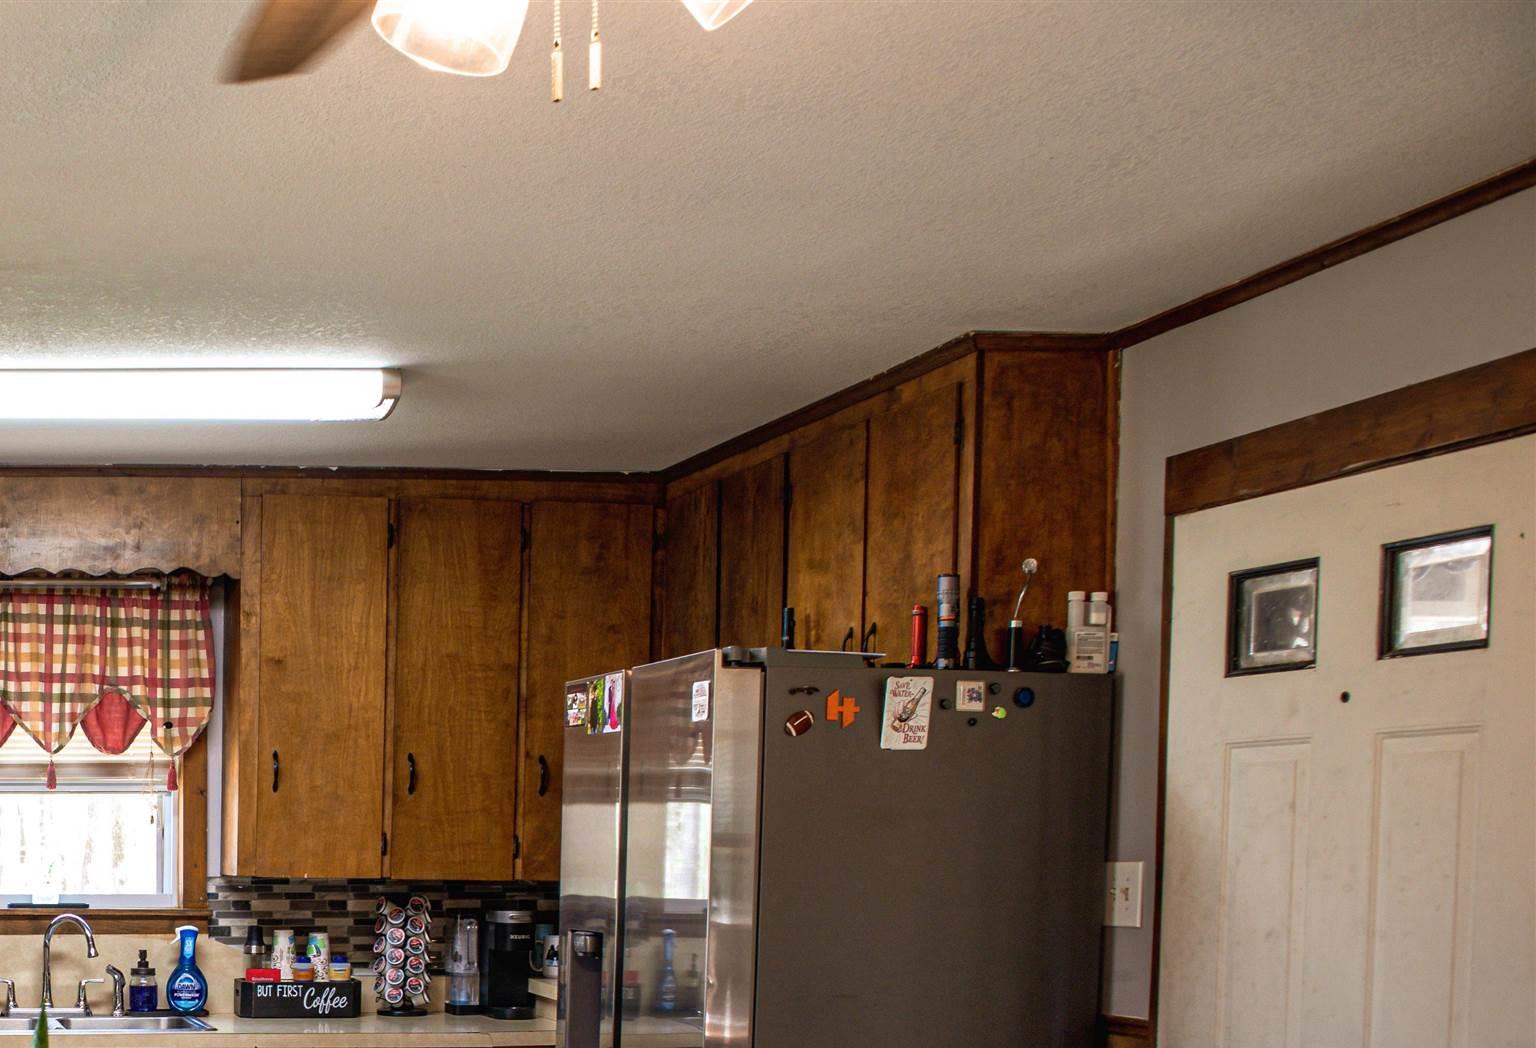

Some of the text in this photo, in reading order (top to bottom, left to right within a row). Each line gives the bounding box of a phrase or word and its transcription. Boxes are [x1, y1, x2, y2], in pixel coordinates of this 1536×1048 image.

[257, 985, 348, 1014] BUT FIRST Coffee
